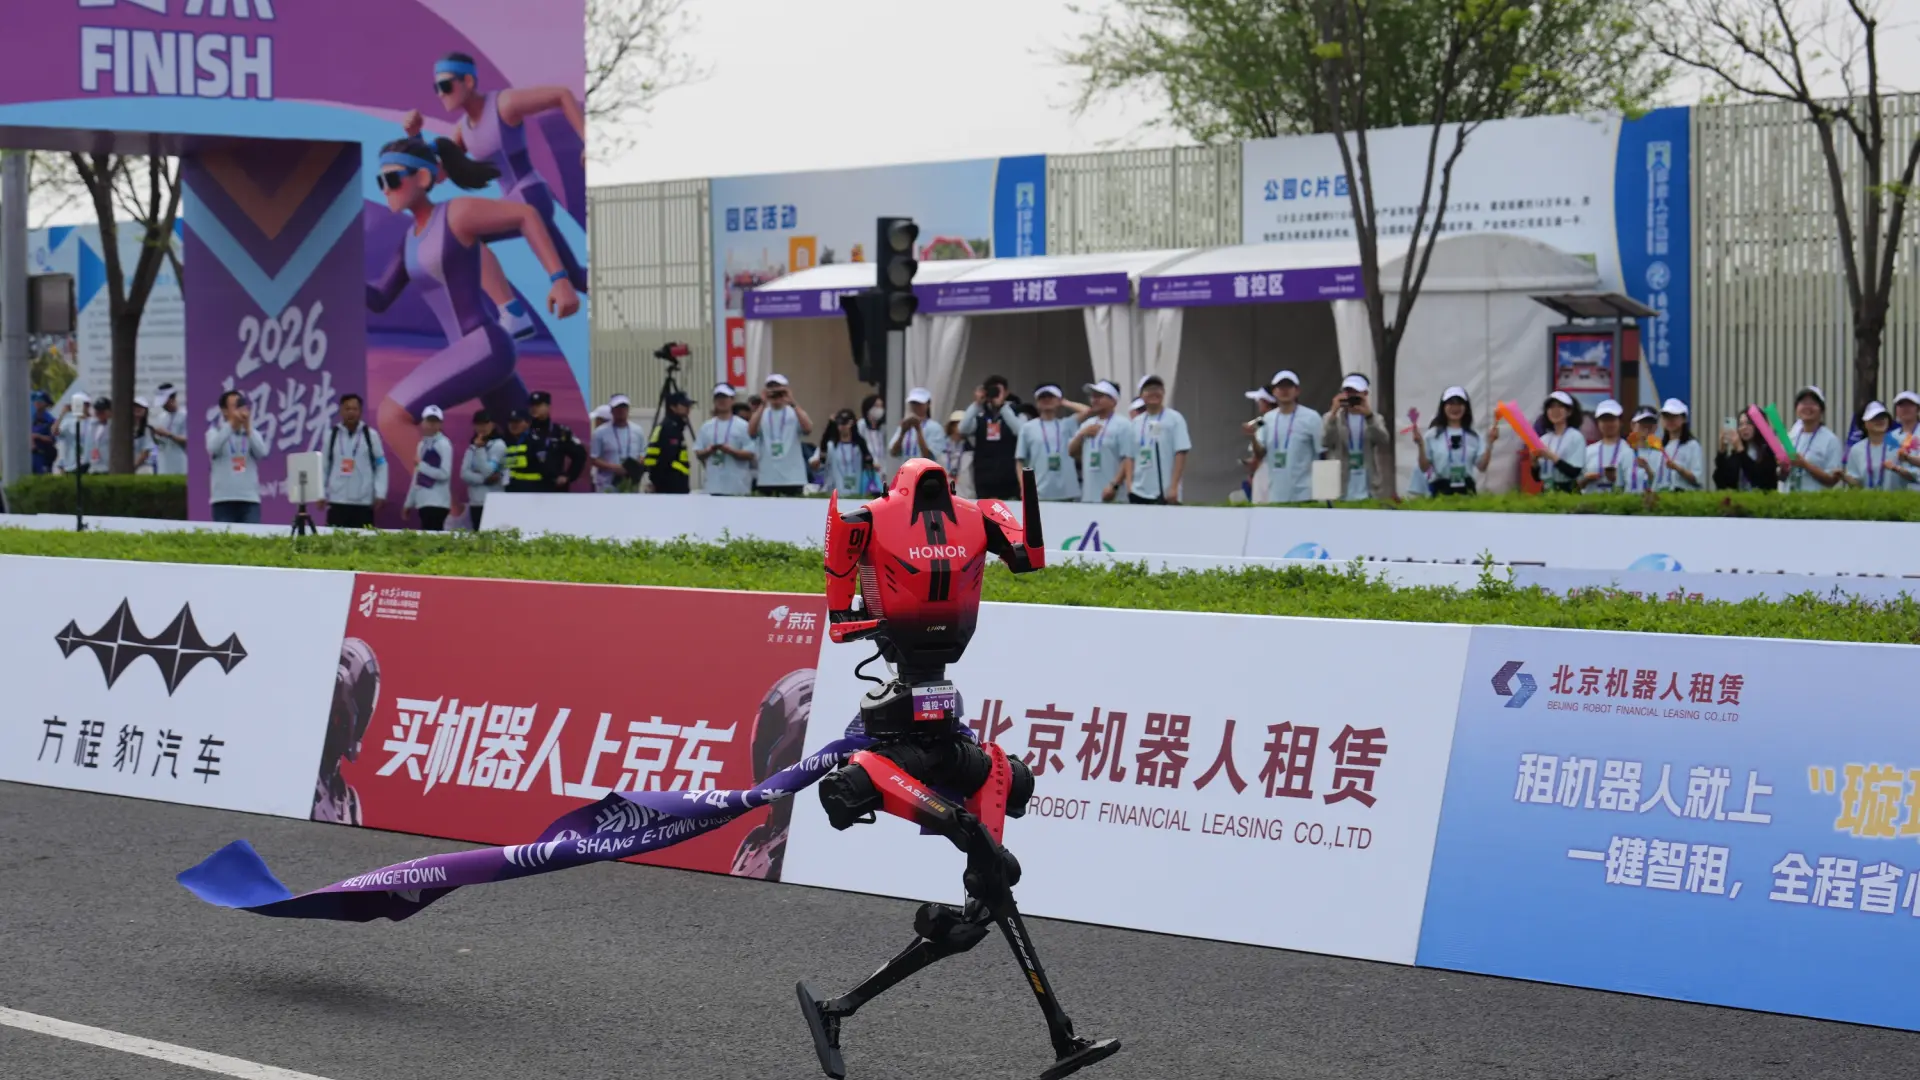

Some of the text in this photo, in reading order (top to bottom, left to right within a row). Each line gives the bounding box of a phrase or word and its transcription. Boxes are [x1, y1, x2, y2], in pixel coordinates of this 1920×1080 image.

[80, 26, 273, 99] FINISH
[726, 204, 797, 232] 园区活动
[1012, 279, 1058, 303] 计时区
[1233, 273, 1285, 298] 音控区
[235, 300, 328, 379] 2026
[206, 370, 339, 458] 马当先
[824, 515, 833, 558] HONOR
[909, 545, 967, 560] HONOR
[787, 611, 817, 630] 京东
[1549, 664, 1745, 706] 北京机器人租赁
[1547, 700, 1579, 712] BEIJING
[1583, 703, 1612, 714] ROBOT
[1616, 705, 1659, 718] FINANCIAL
[1663, 708, 1700, 721] LEASING
[37, 715, 226, 785] 方程豹汽车
[375, 695, 738, 801] 买机器人上京东
[968, 698, 1389, 809] 北京机器人租赁
[889, 774, 930, 802] FLASH
[576, 835, 635, 854] SHANG
[641, 818, 696, 844] E-TOWN
[1028, 795, 1373, 850] ROBOT FINANCIAL LEASING CO.,LTD
[341, 866, 448, 889] BEIJINGETOWN
[1007, 916, 1035, 971] SPEED
